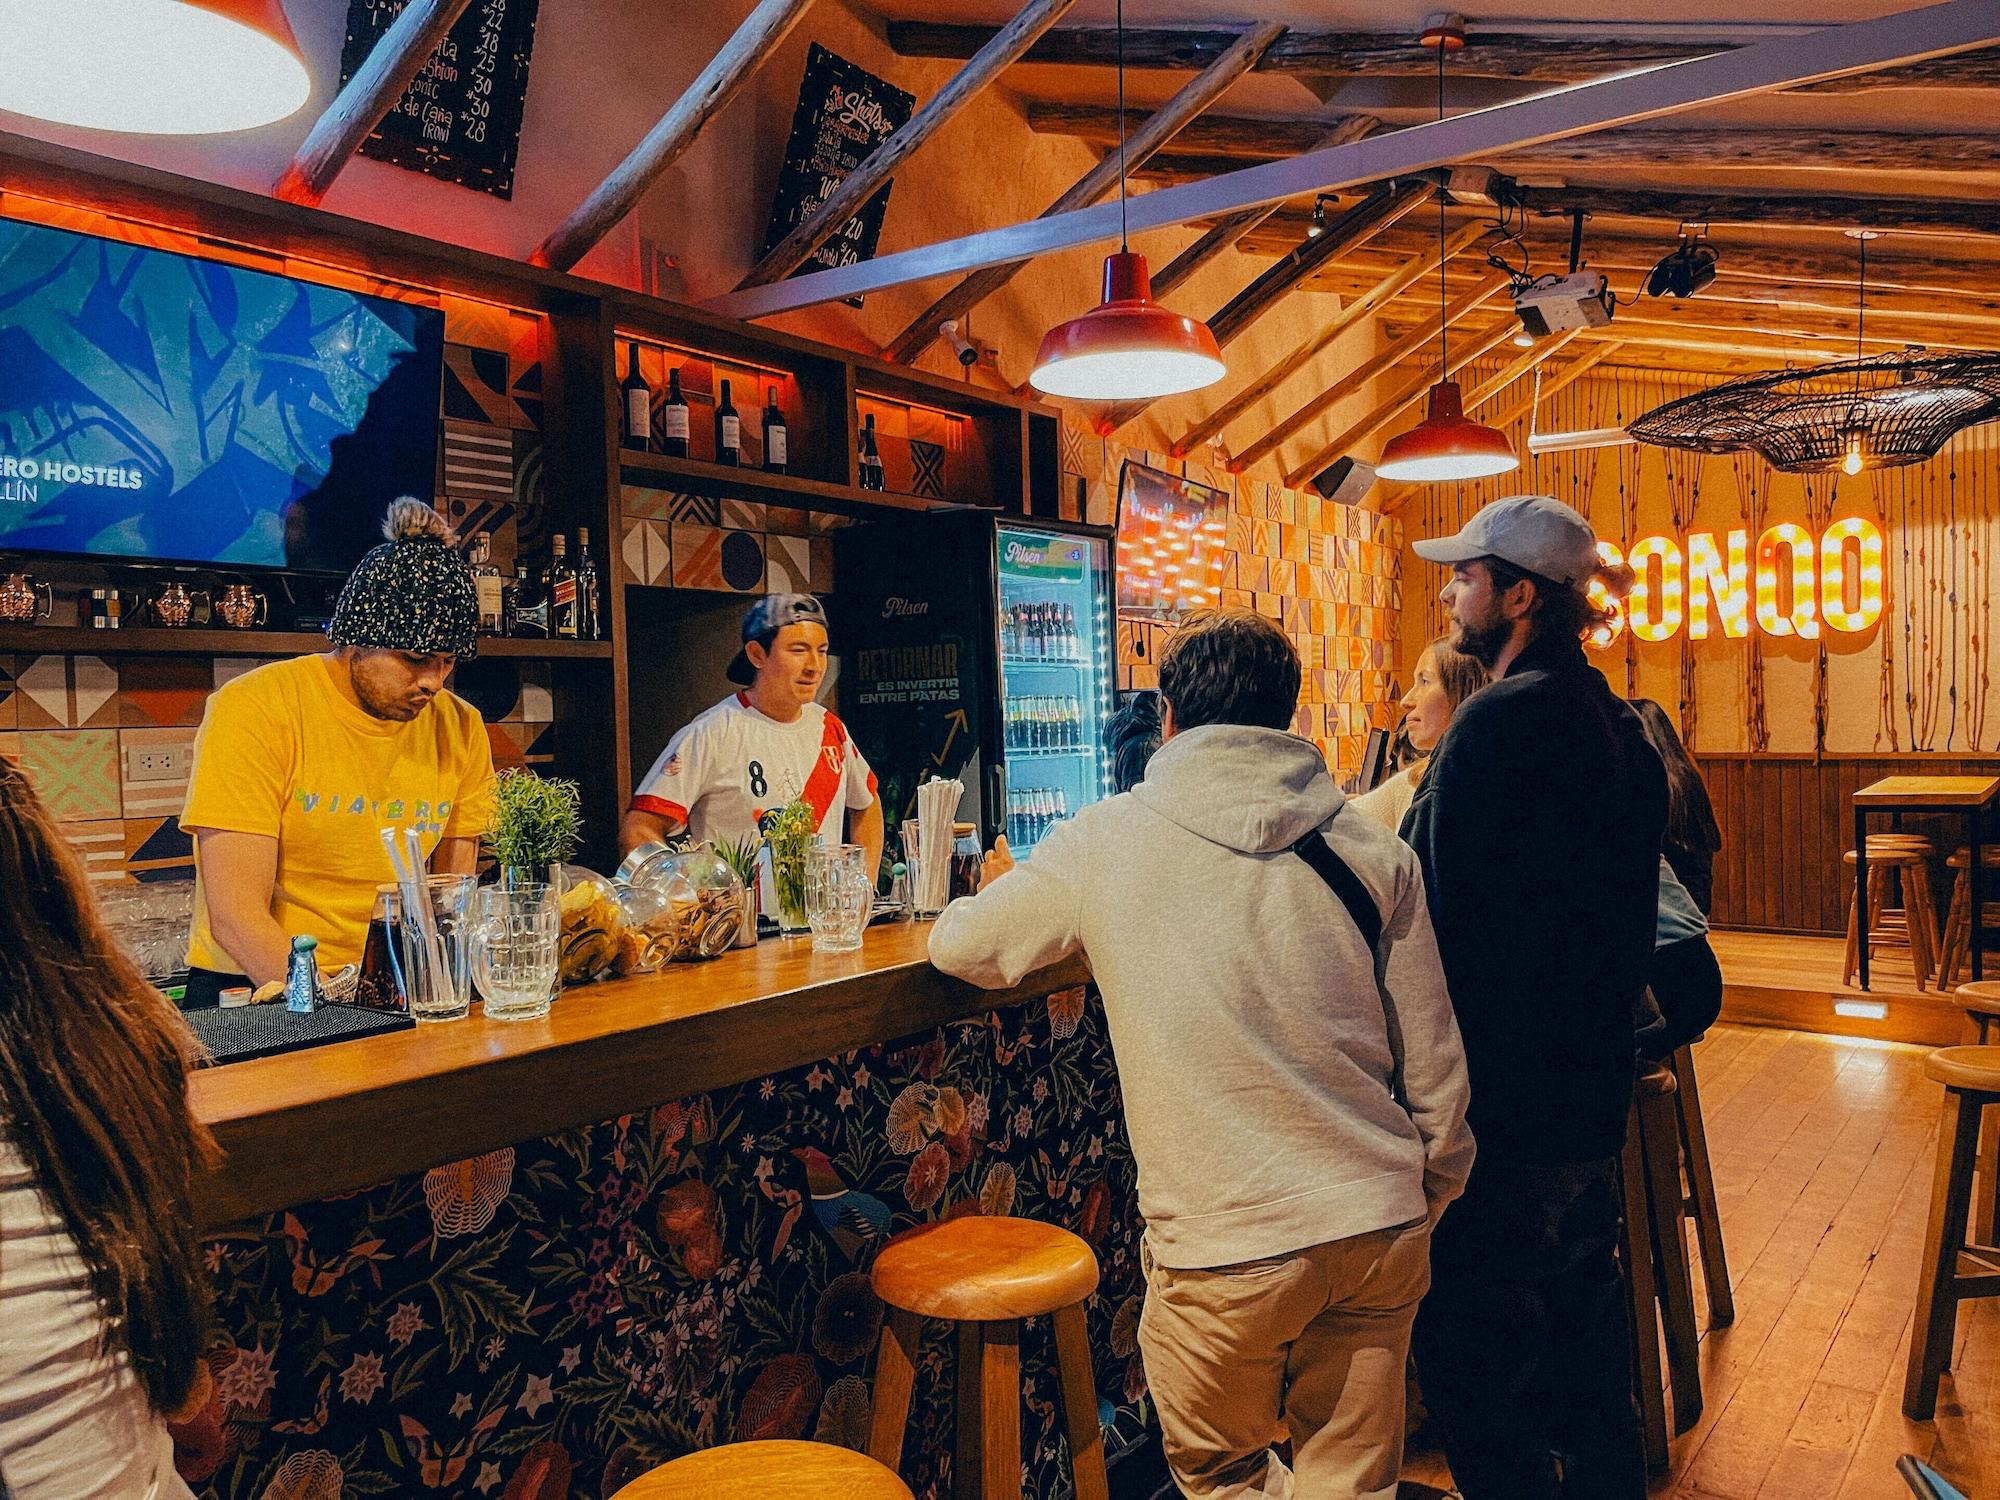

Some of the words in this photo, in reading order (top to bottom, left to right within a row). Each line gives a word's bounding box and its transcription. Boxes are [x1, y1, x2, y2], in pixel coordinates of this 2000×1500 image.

[44, 461, 144, 490] HOSTELS
[1004, 541, 1042, 565] Pilsen
[882, 597, 929, 619] Pilsen
[877, 682, 895, 691] ES
[897, 678, 959, 690] INVERTIR
[859, 692, 907, 704] ENTRE
[909, 689, 960, 702] PATAS
[748, 760, 768, 798] 8
